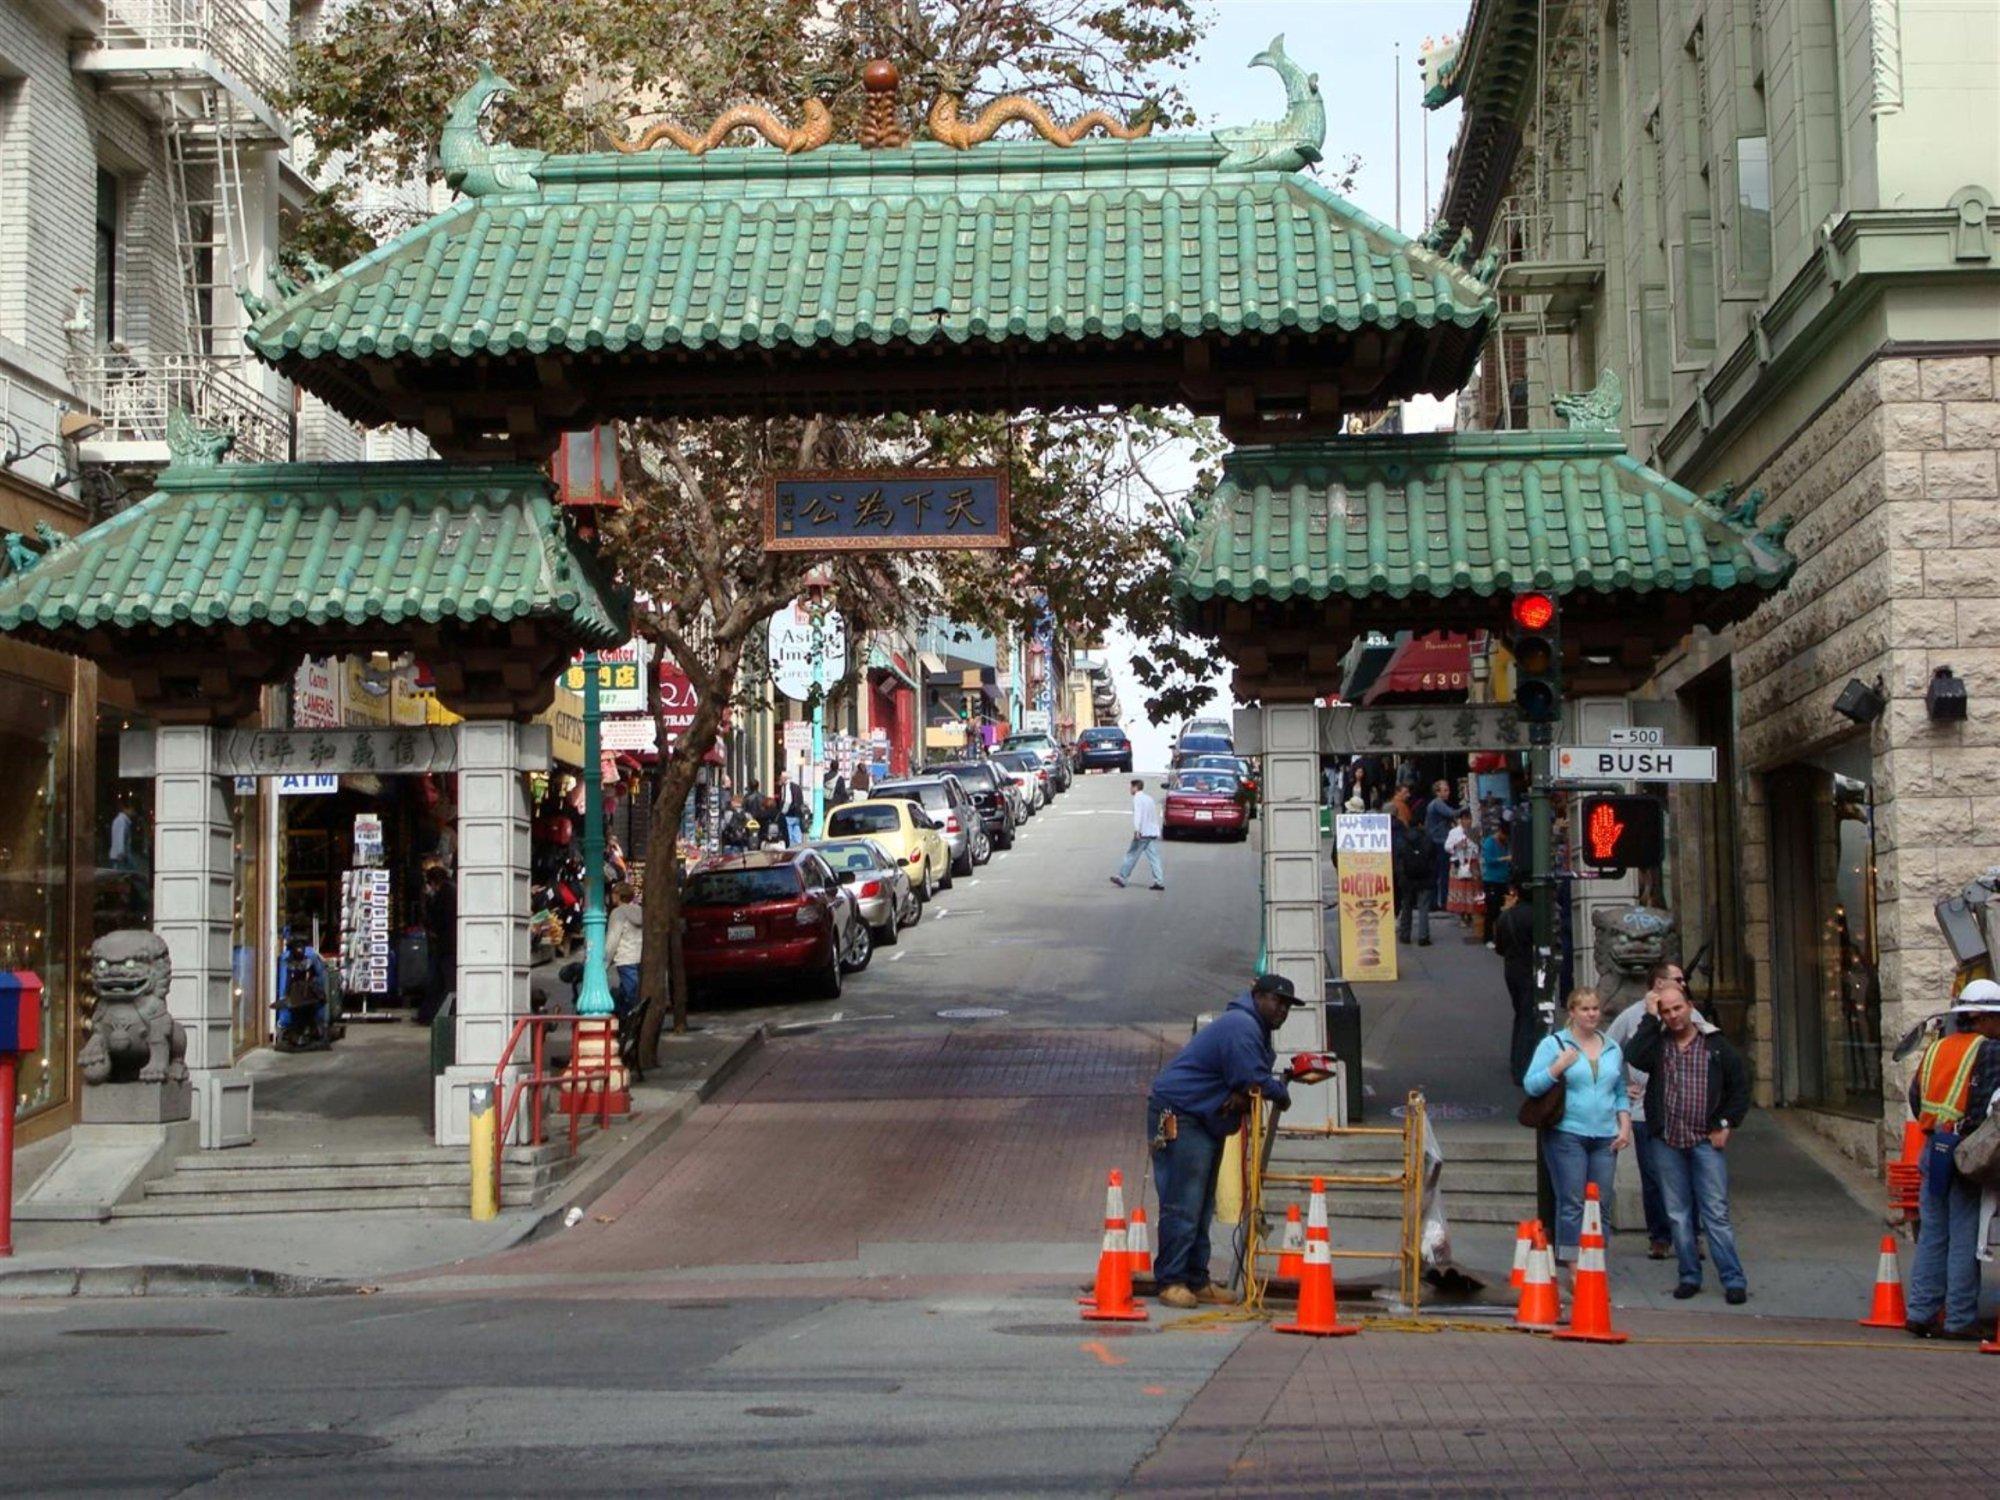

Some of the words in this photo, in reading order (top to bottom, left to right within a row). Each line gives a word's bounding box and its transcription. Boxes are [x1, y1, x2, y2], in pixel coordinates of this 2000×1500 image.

[1422, 672, 1460, 685] 430
[556, 711, 582, 746] GIFTS
[1629, 731, 1658, 743] 500
[1599, 755, 1673, 773] BUSH
[283, 774, 334, 788] ATM
[1341, 833, 1388, 848] ATM
[1341, 872, 1390, 898] DIGITAL
